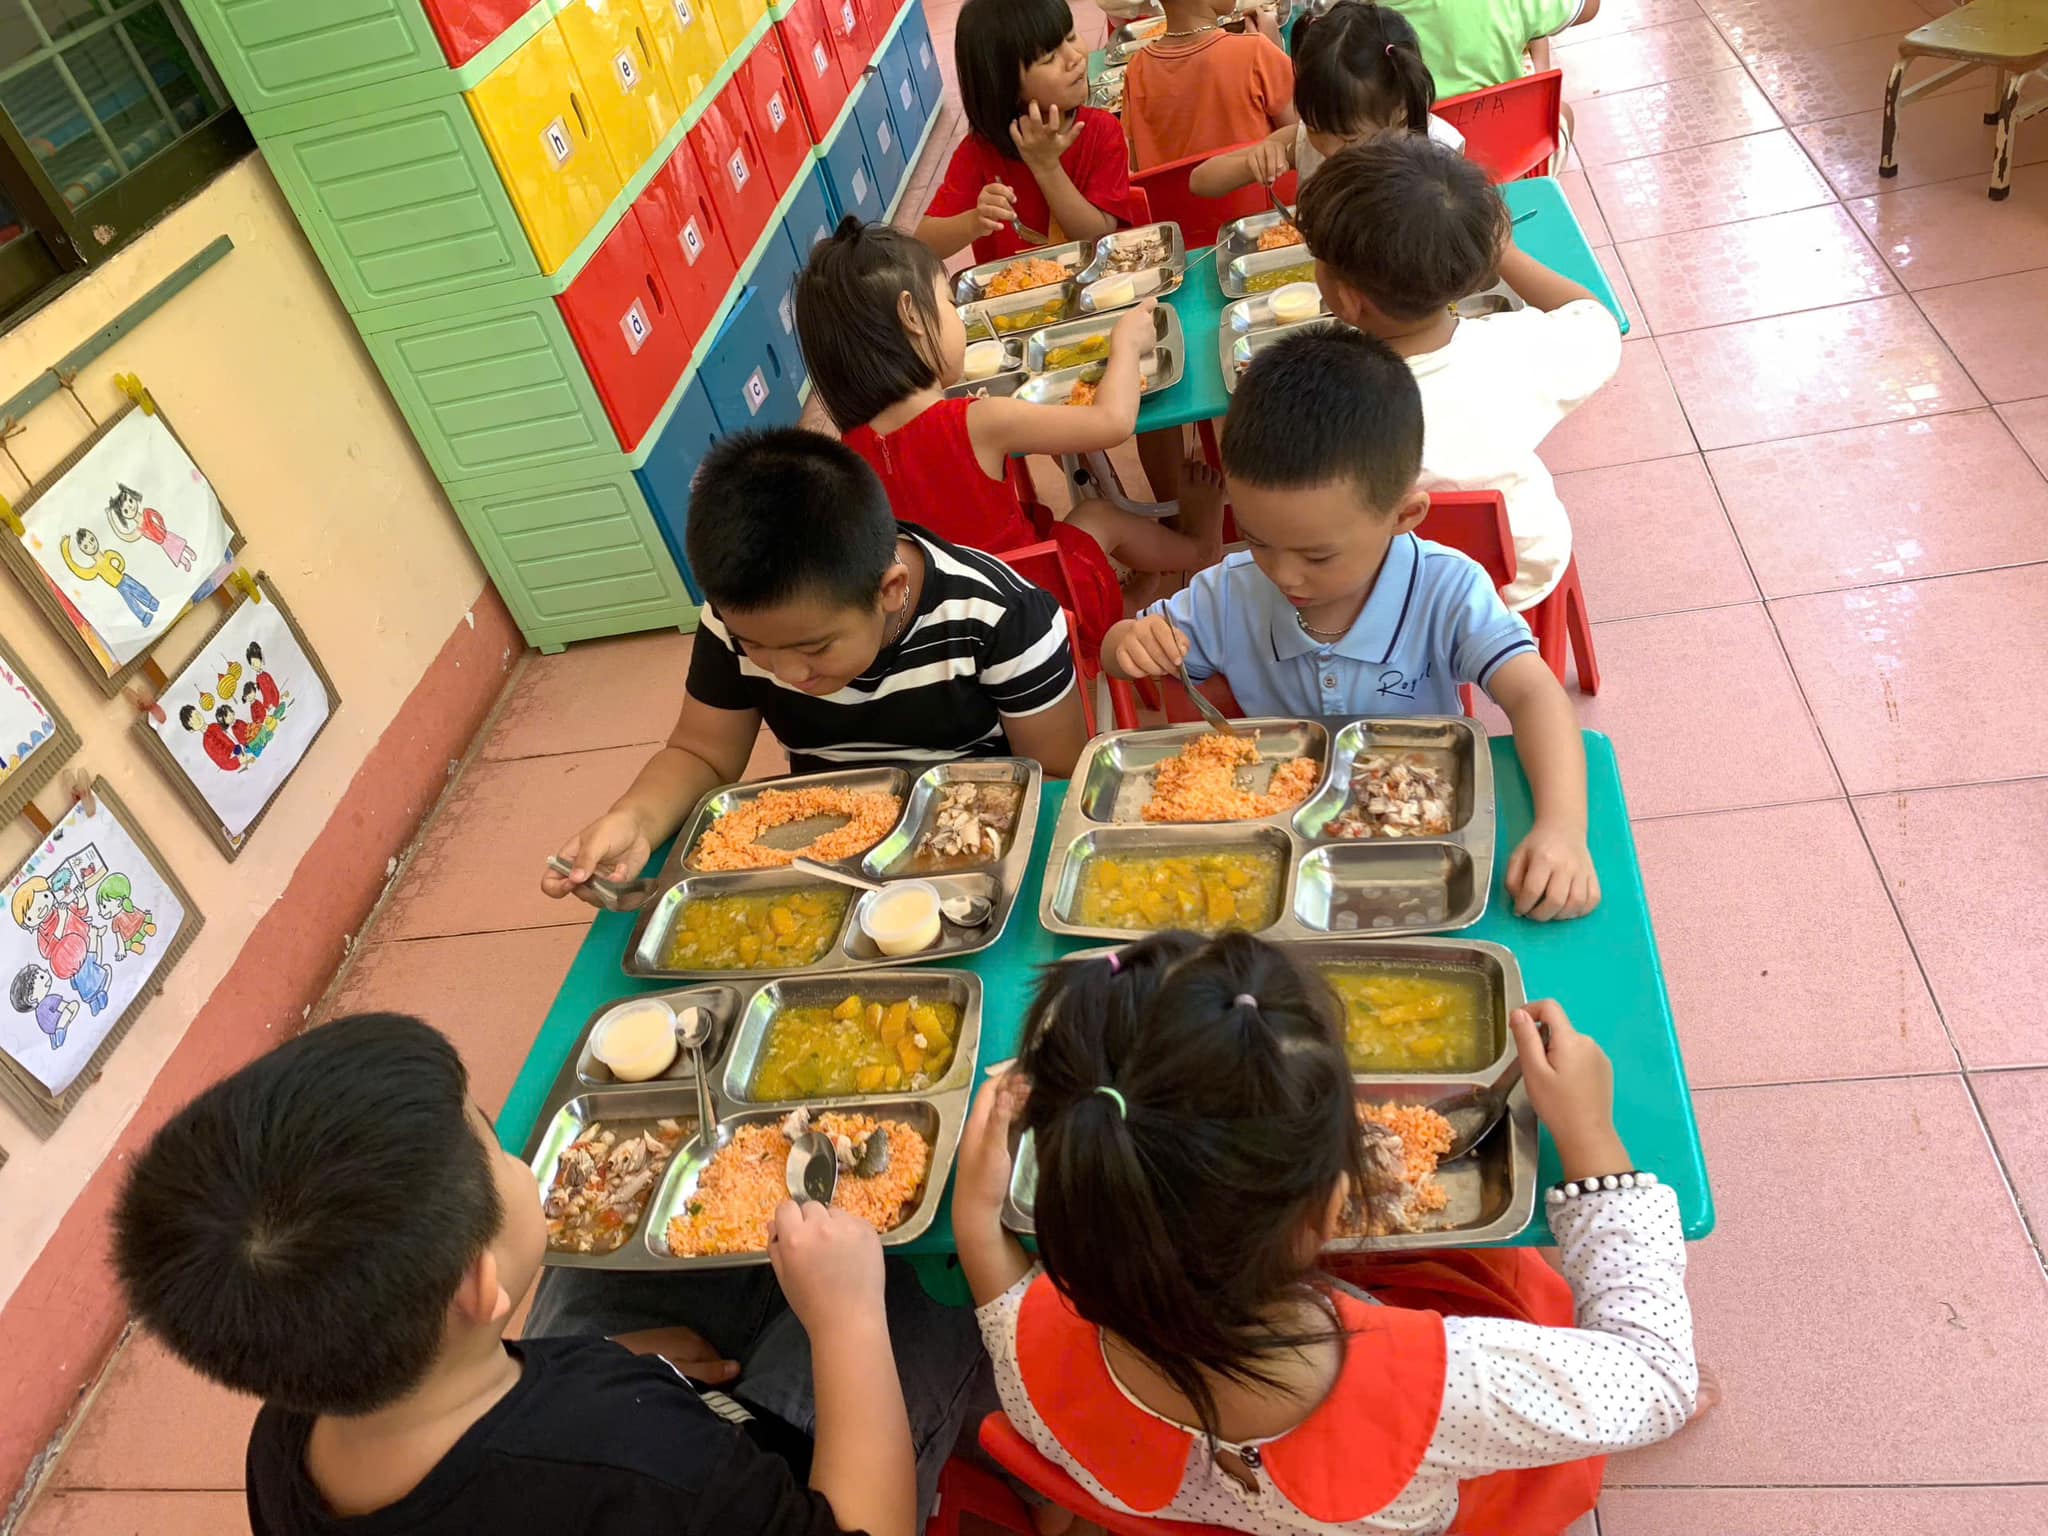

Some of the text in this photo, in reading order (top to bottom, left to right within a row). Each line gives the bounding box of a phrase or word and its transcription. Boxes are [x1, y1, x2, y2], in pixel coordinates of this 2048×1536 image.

[622, 61, 631, 77] e
[551, 133, 565, 154] h
[631, 314, 643, 335] â
[752, 382, 761, 396] c
